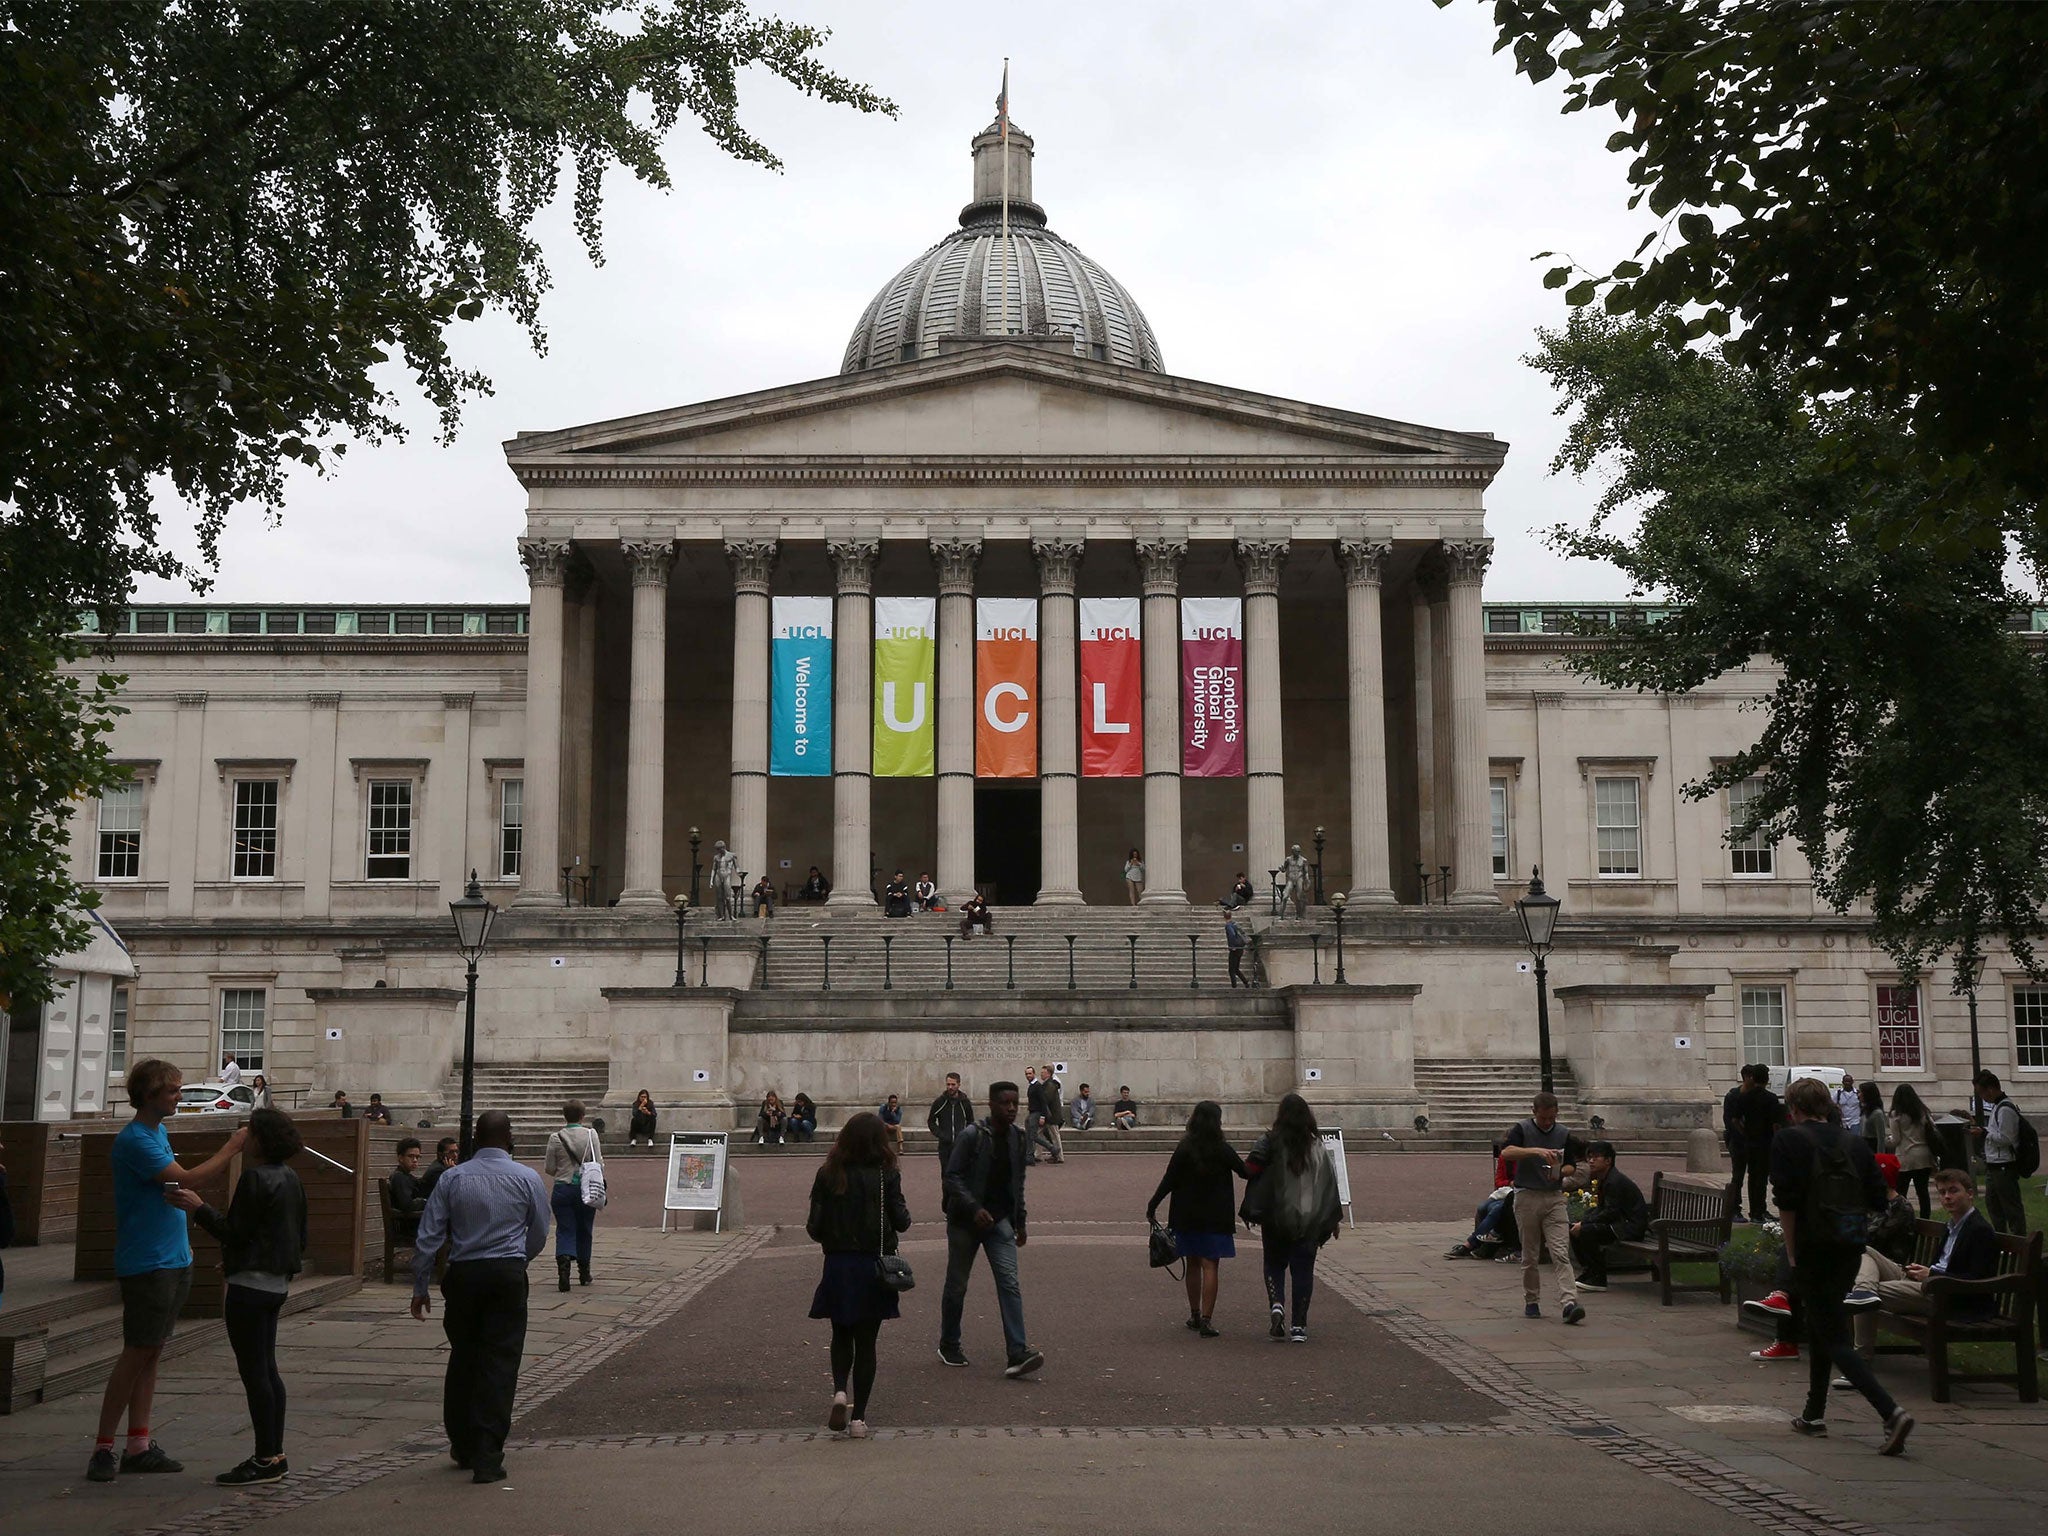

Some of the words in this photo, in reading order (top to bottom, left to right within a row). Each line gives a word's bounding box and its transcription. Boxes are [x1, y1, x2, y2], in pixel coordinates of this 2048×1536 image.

[788, 626, 827, 639] UCL
[892, 626, 929, 640] UCL
[993, 627, 1032, 640] UCL
[1097, 627, 1135, 640] UCL
[1199, 627, 1236, 640] UCL
[795, 656, 811, 735] Welcome
[1208, 666, 1223, 720] Global
[883, 681, 926, 733] U
[984, 682, 1030, 733] C
[1093, 682, 1130, 734] L
[1191, 666, 1209, 750] University
[1224, 666, 1240, 743] London's
[795, 737, 809, 756] to
[1879, 1009, 1918, 1023] UCL
[1880, 1030, 1918, 1044] ART
[1881, 1052, 1920, 1060] MUSEUM
[705, 1138, 724, 1146] UCL
